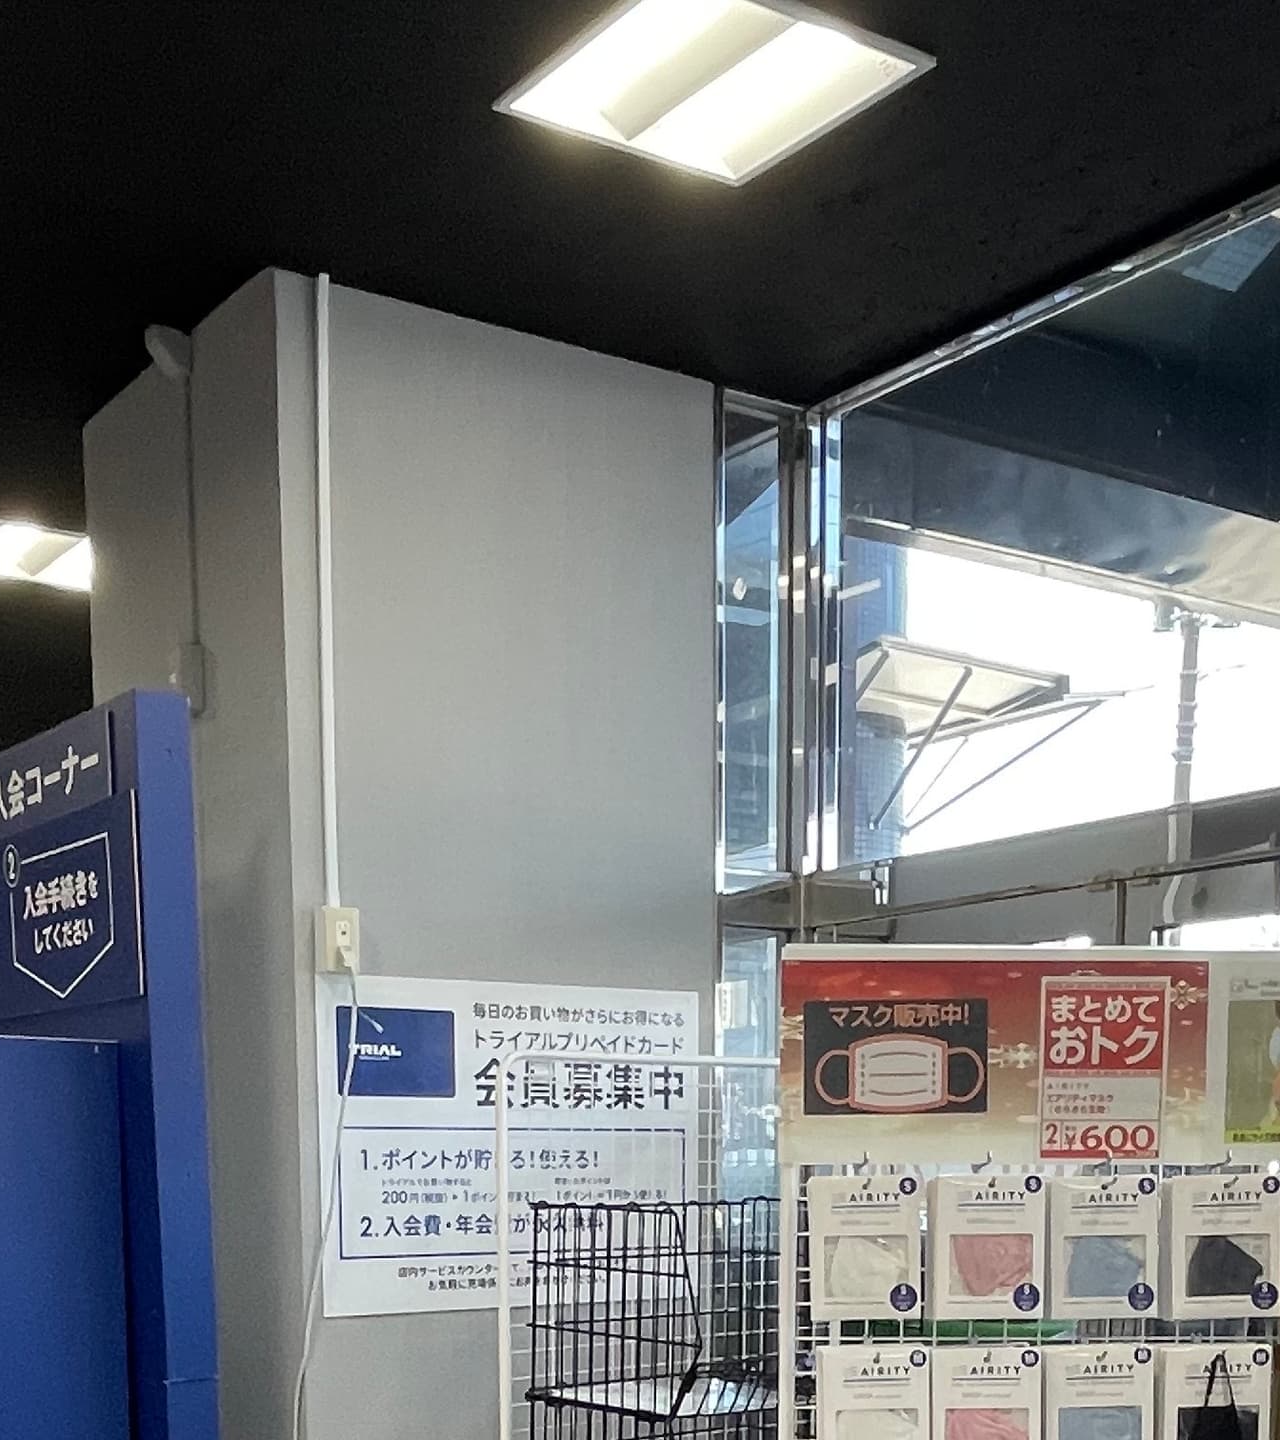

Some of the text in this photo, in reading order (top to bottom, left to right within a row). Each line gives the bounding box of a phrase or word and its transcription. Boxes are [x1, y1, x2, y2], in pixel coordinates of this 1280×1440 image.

[23, 870, 98, 920] 入会手続きを
[34, 918, 95, 955] してください
[472, 1001, 685, 1028] 毎日のお買い物がさらにお得になる
[829, 1003, 970, 1028] マスク販売中!
[1051, 994, 1160, 1024] まとめて
[348, 1043, 402, 1057] TRIAL
[474, 1028, 684, 1055] トライアルプリペイドカード
[1049, 1025, 1160, 1066] おトク
[473, 1057, 684, 1110] 会員募集中
[1045, 1123, 1058, 1145] 2
[850, 1192, 900, 1201] AIRITY
[975, 1190, 1026, 1200] AIRITY
[1089, 1193, 1139, 1202] AIRITY
[1210, 1191, 1262, 1201] AIRITY
[861, 1366, 911, 1375] AIRITY
[970, 1365, 1021, 1375] AIRITY
[1084, 1364, 1134, 1374] AIRITY
